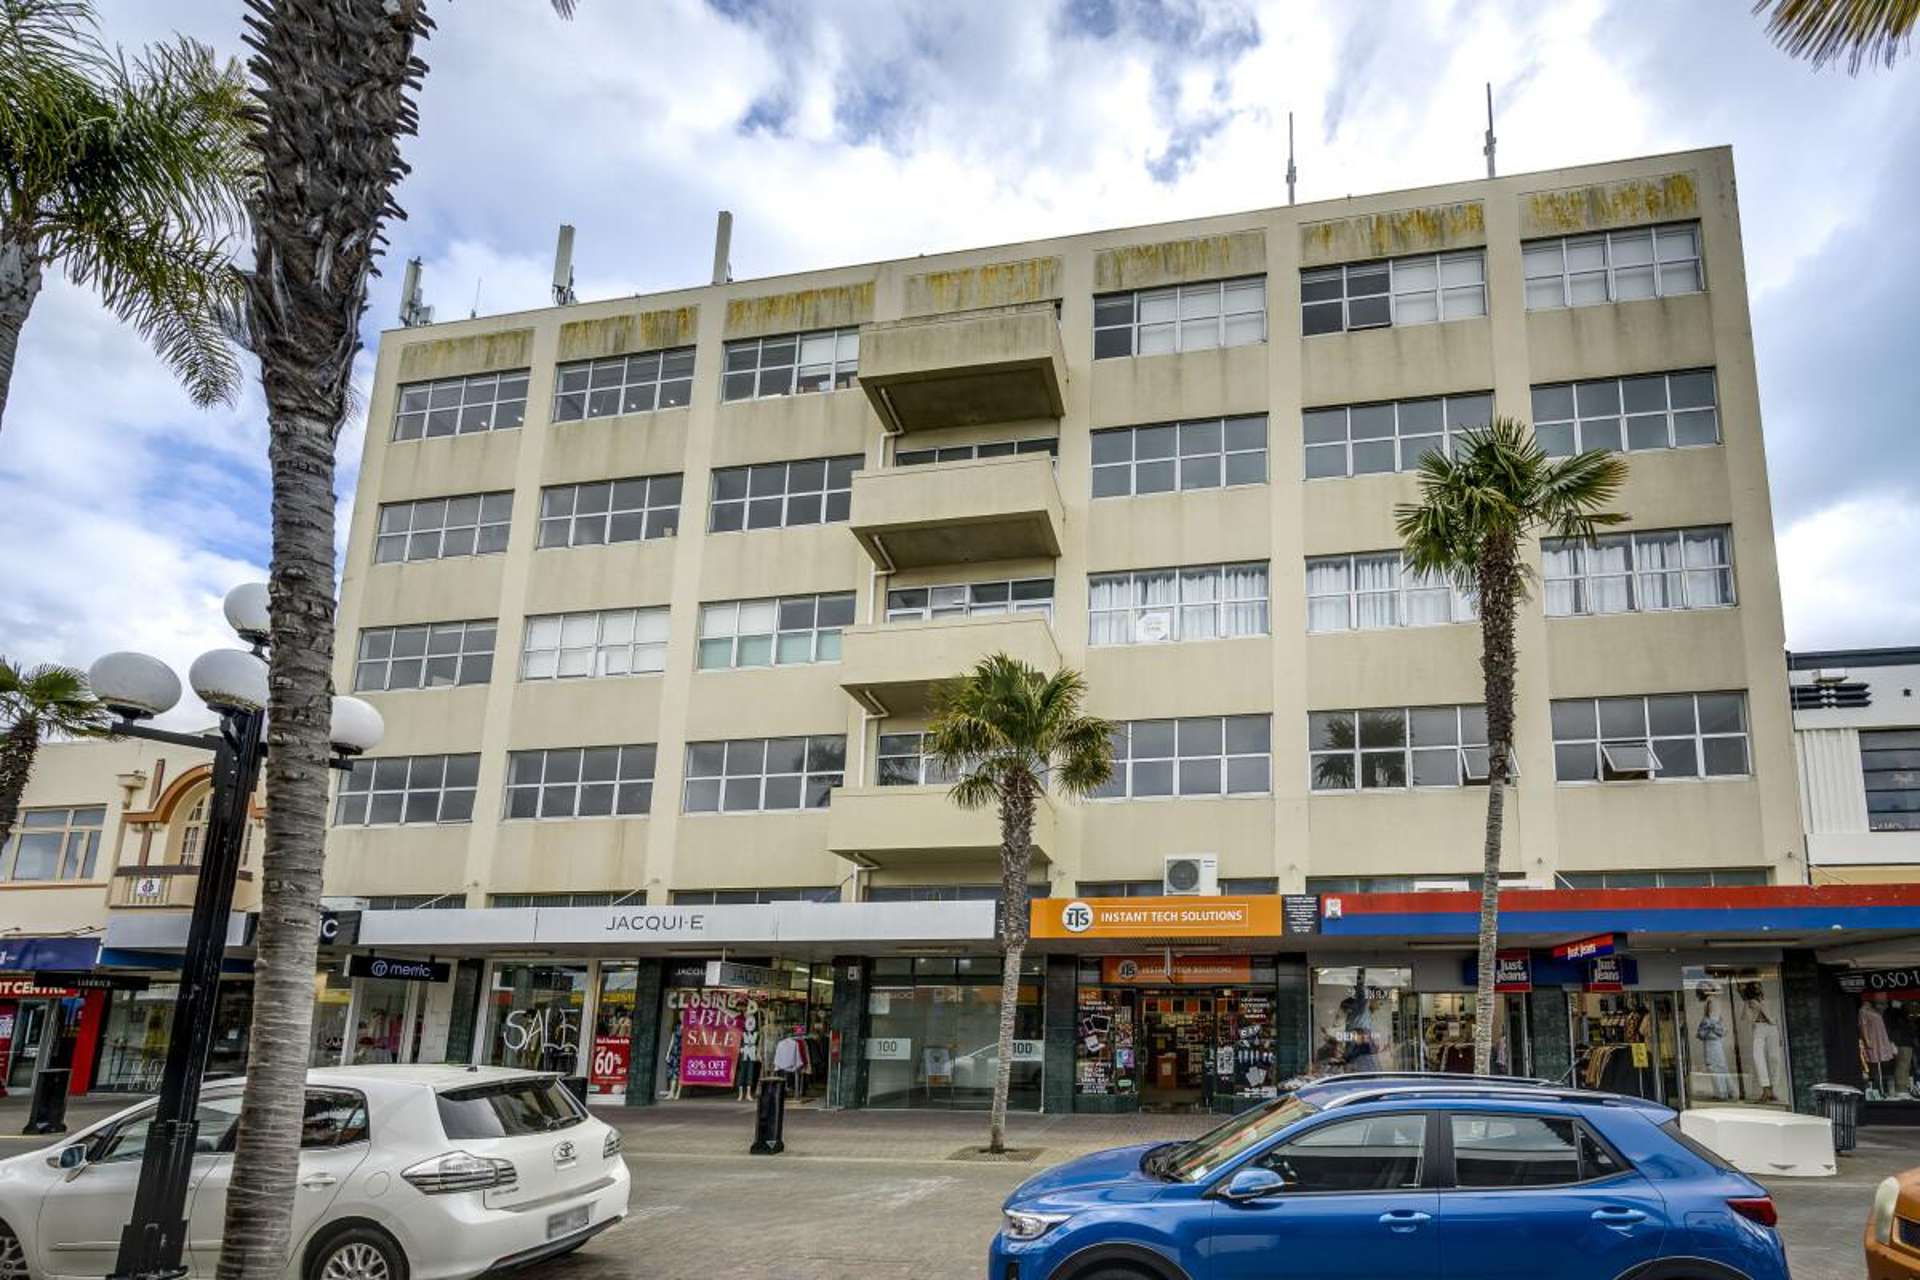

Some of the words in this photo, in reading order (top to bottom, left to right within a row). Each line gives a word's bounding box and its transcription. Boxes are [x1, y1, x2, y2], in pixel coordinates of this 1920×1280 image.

[1067, 908, 1089, 928] ITS
[1101, 912, 1147, 923] INSTANT
[1151, 911, 1178, 922] TECH
[1181, 910, 1243, 921] SOLUTIONS
[389, 964, 431, 977] merric
[667, 991, 741, 1011] CLOSING
[700, 1009, 737, 1027] BIG
[503, 1007, 579, 1053] SALE
[687, 1030, 736, 1048] SALE
[877, 1040, 897, 1052] 100
[1013, 1042, 1033, 1054] 100
[708, 1060, 727, 1070] OFF
